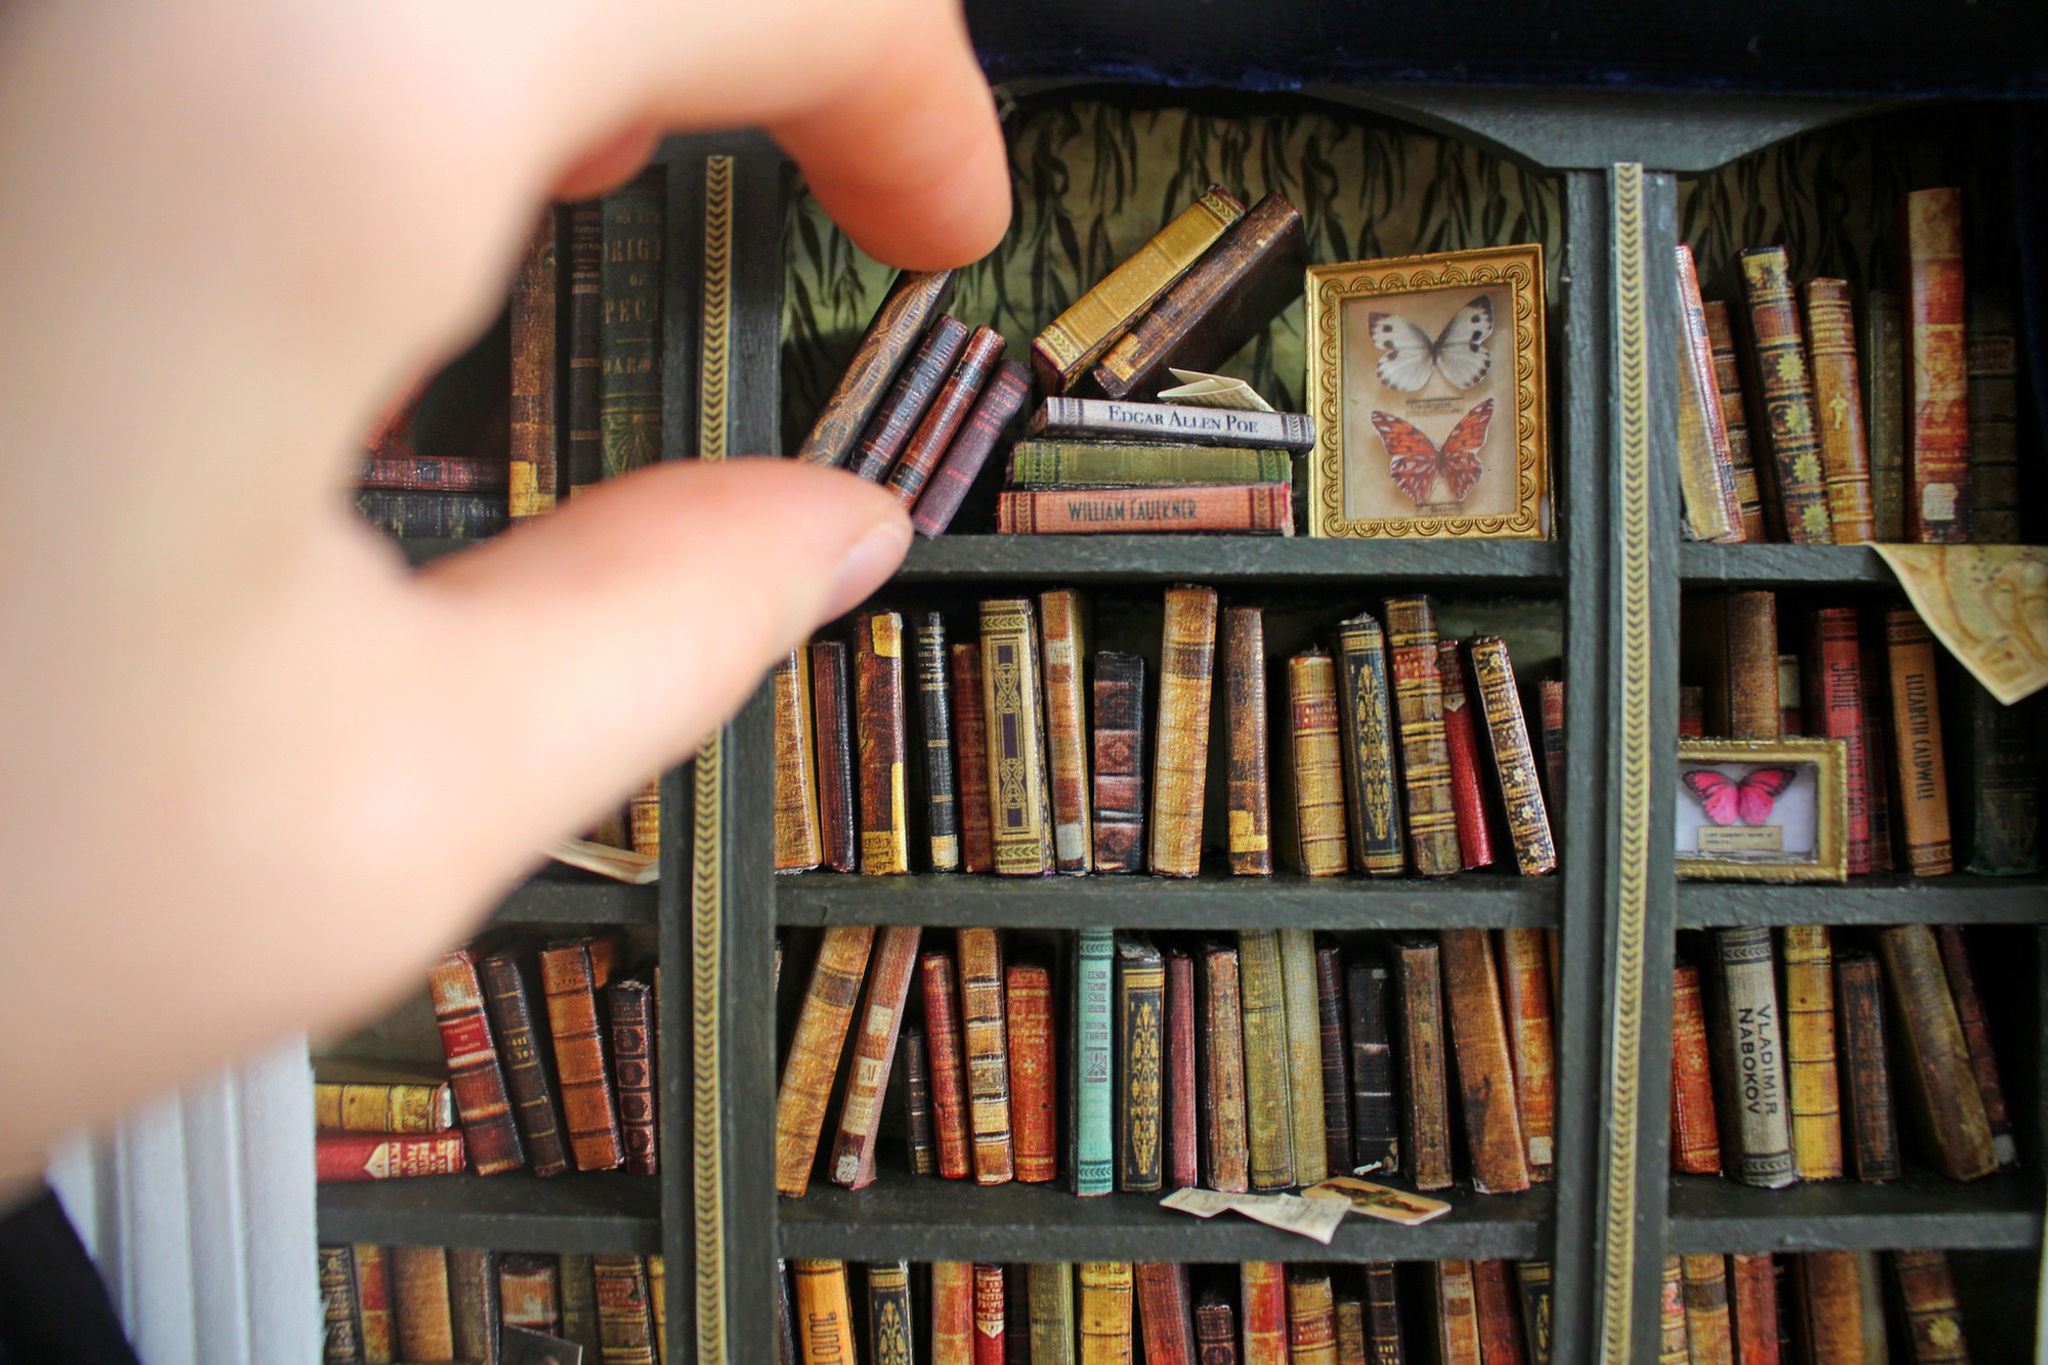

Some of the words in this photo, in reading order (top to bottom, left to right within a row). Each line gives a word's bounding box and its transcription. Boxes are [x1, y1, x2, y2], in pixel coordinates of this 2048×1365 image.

[1108, 405, 1164, 424] EDGAR
[1168, 410, 1221, 430] ALLEN
[1226, 414, 1259, 433] POE
[1068, 500, 1125, 522] WILLIAM
[1130, 498, 1197, 520] FAULKNER
[1906, 673, 1930, 735] ELIZABETH
[1913, 739, 1937, 800] CALDWELL
[1738, 1008, 1760, 1114] NABOKOV
[1757, 1004, 1778, 1115] VLADIMIR
